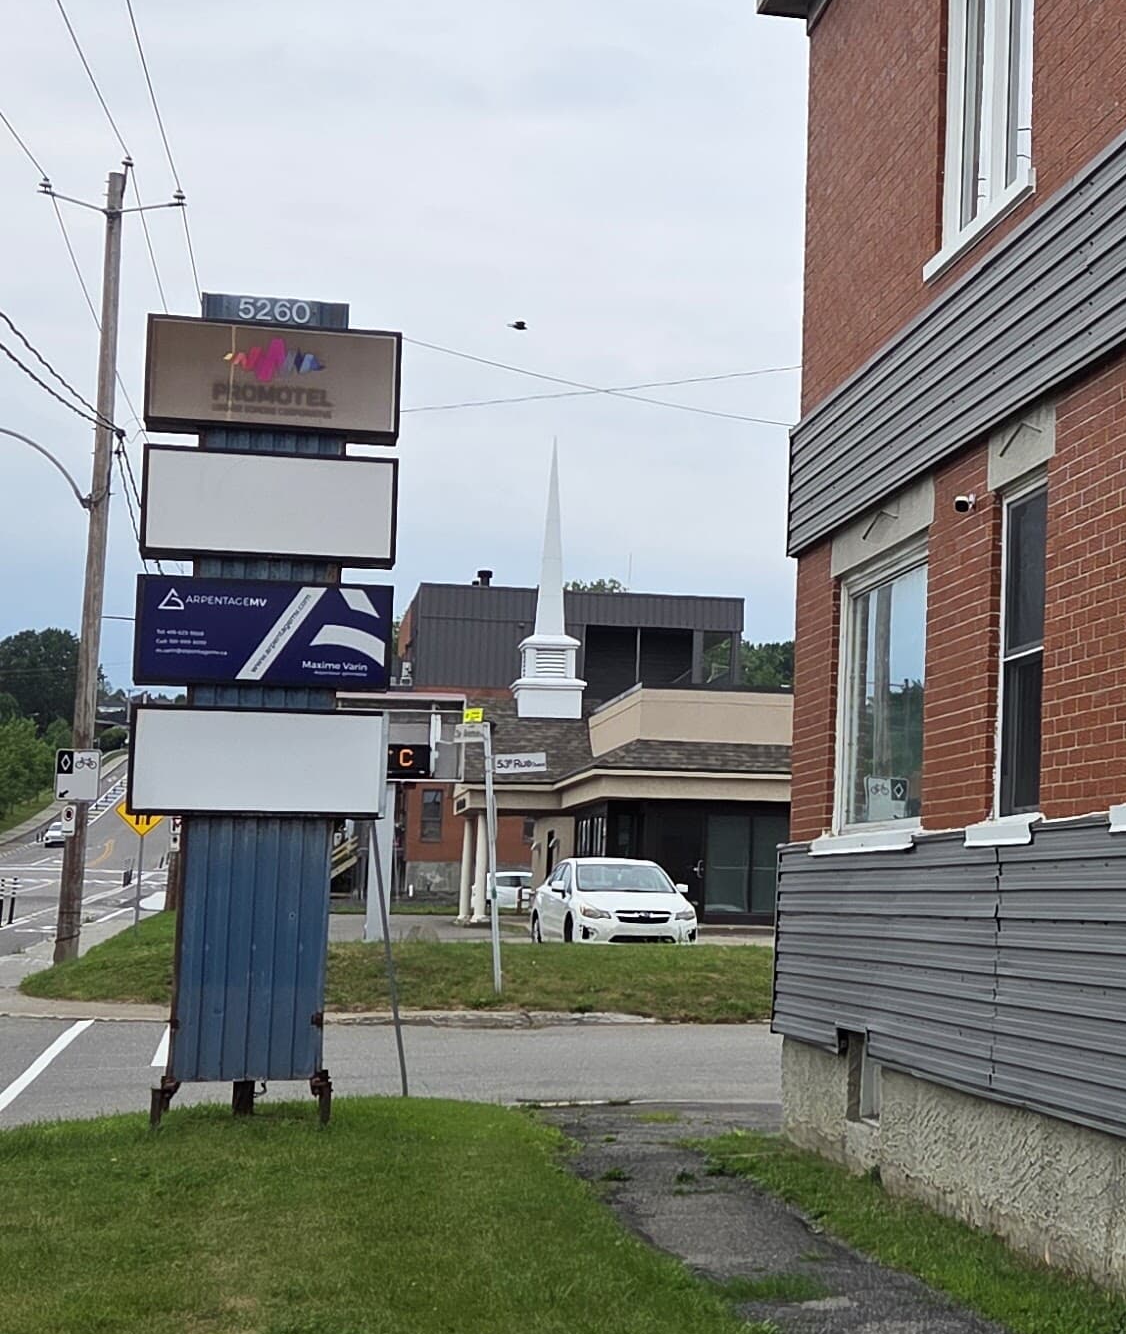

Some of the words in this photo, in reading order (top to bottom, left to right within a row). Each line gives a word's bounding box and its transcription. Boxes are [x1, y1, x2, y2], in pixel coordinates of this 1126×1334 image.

[238, 298, 311, 324] 5260
[211, 382, 333, 408] PROMOTEL
[302, 660, 341, 670] Maxime
[342, 662, 368, 671] Varin
